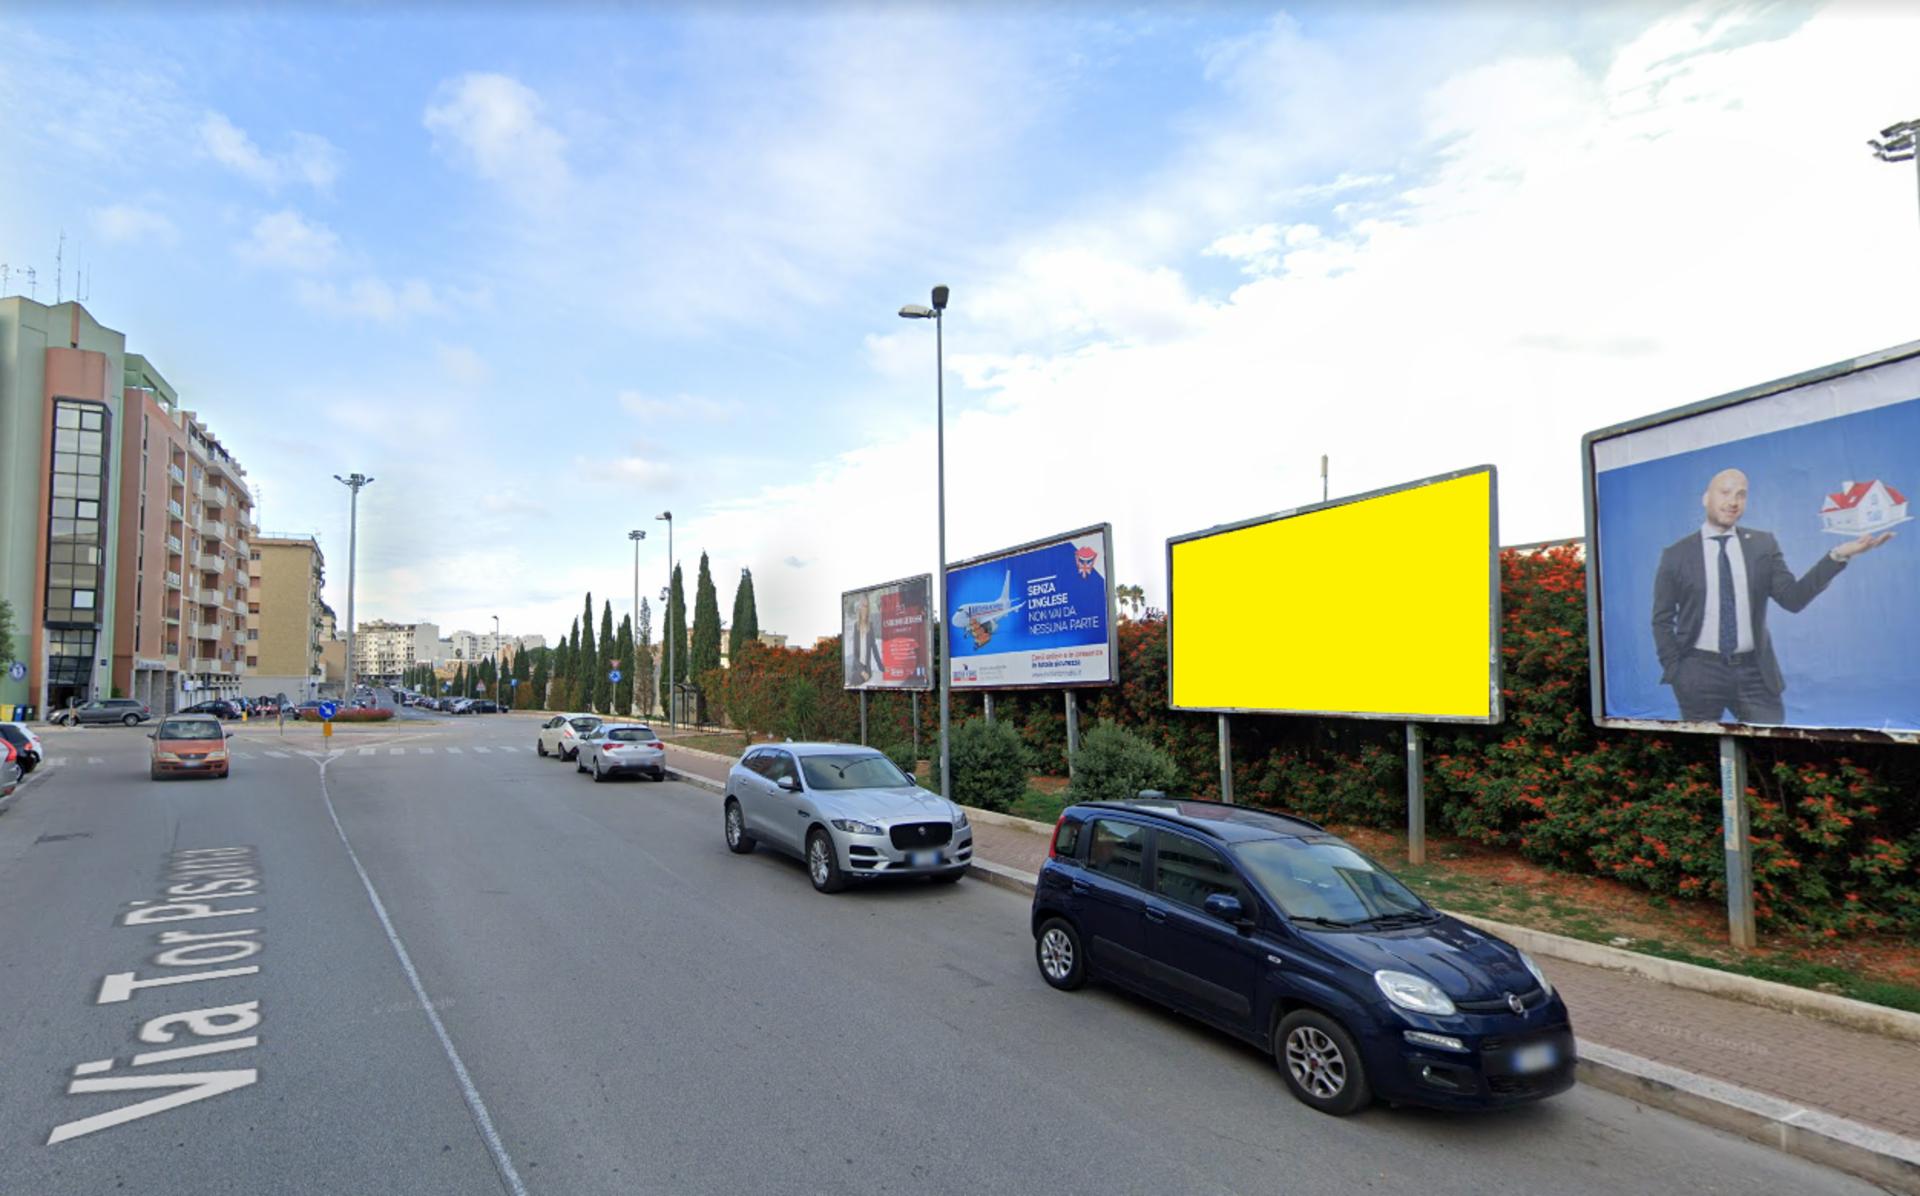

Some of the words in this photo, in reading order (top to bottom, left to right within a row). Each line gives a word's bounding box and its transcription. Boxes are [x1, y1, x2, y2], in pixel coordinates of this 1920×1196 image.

[1027, 582, 1056, 596] SENZA
[1028, 609, 1047, 622] NON
[1048, 607, 1062, 619] VAI
[1063, 605, 1077, 617] DA
[1030, 620, 1068, 635] NESSUNA
[1070, 616, 1099, 631] PARTE
